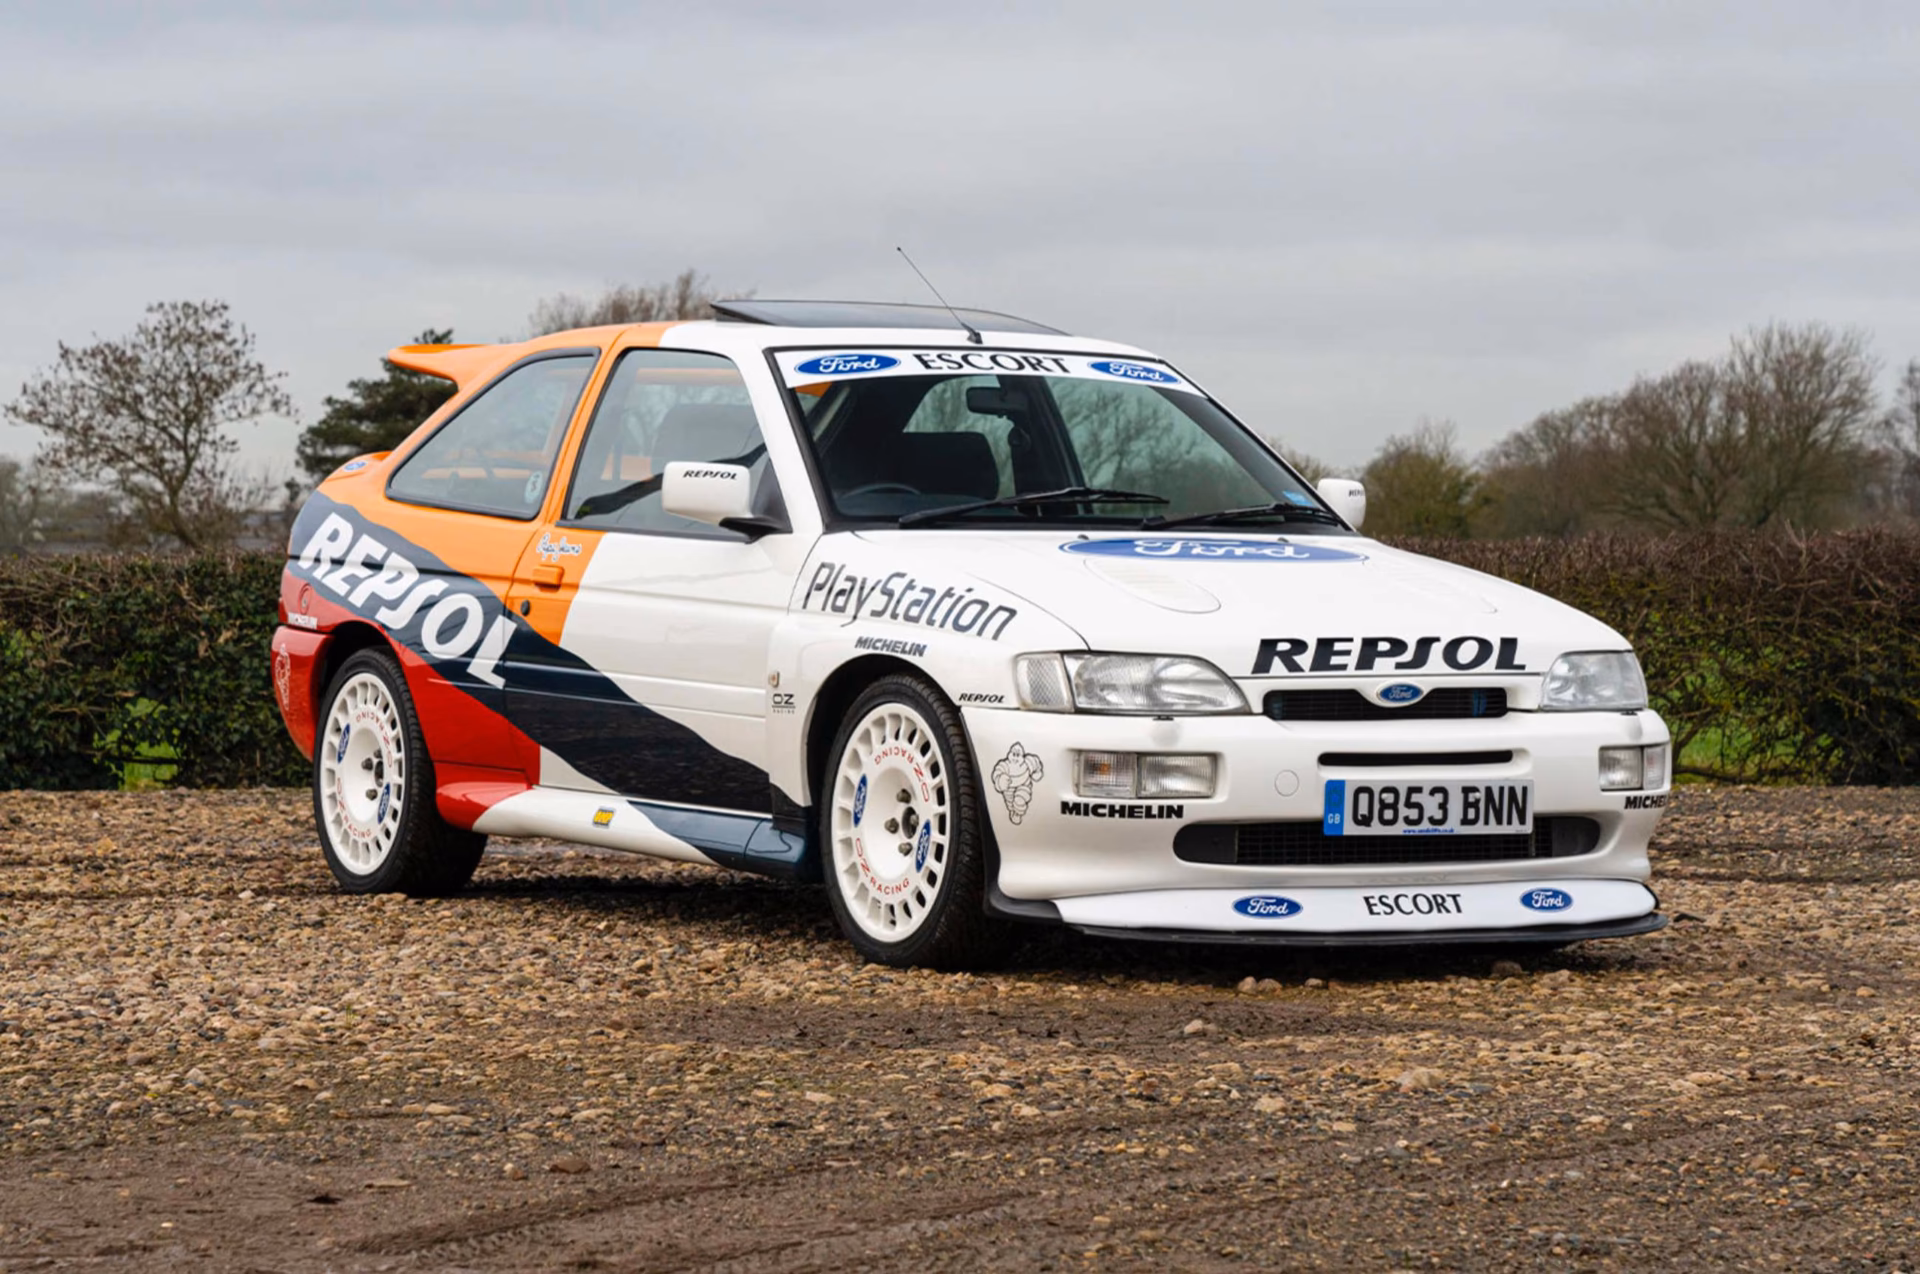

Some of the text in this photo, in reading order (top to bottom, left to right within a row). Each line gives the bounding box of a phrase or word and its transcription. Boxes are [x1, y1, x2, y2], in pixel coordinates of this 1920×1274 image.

[819, 355, 881, 373] Ford
[912, 353, 1072, 374] ESCORT
[1108, 361, 1165, 382] Ford
[683, 470, 738, 480] REPSOL
[1134, 538, 1310, 559] Ford
[297, 512, 518, 690] REPSOL
[801, 561, 1018, 641] PlayStation
[855, 636, 927, 658] MICHELIN
[1251, 636, 1527, 675] REPSOL
[772, 693, 795, 705] OZ
[958, 692, 1005, 704] REPSOL
[874, 746, 915, 765] RACING
[1060, 801, 1184, 819] MICHELIN
[1352, 786, 1528, 828] Q853 BNN
[1327, 813, 1341, 824] GB
[870, 876, 910, 895] RACING
[1247, 897, 1289, 914] Ford
[1362, 893, 1463, 916] ESCORT
[1531, 890, 1565, 908] Ford
